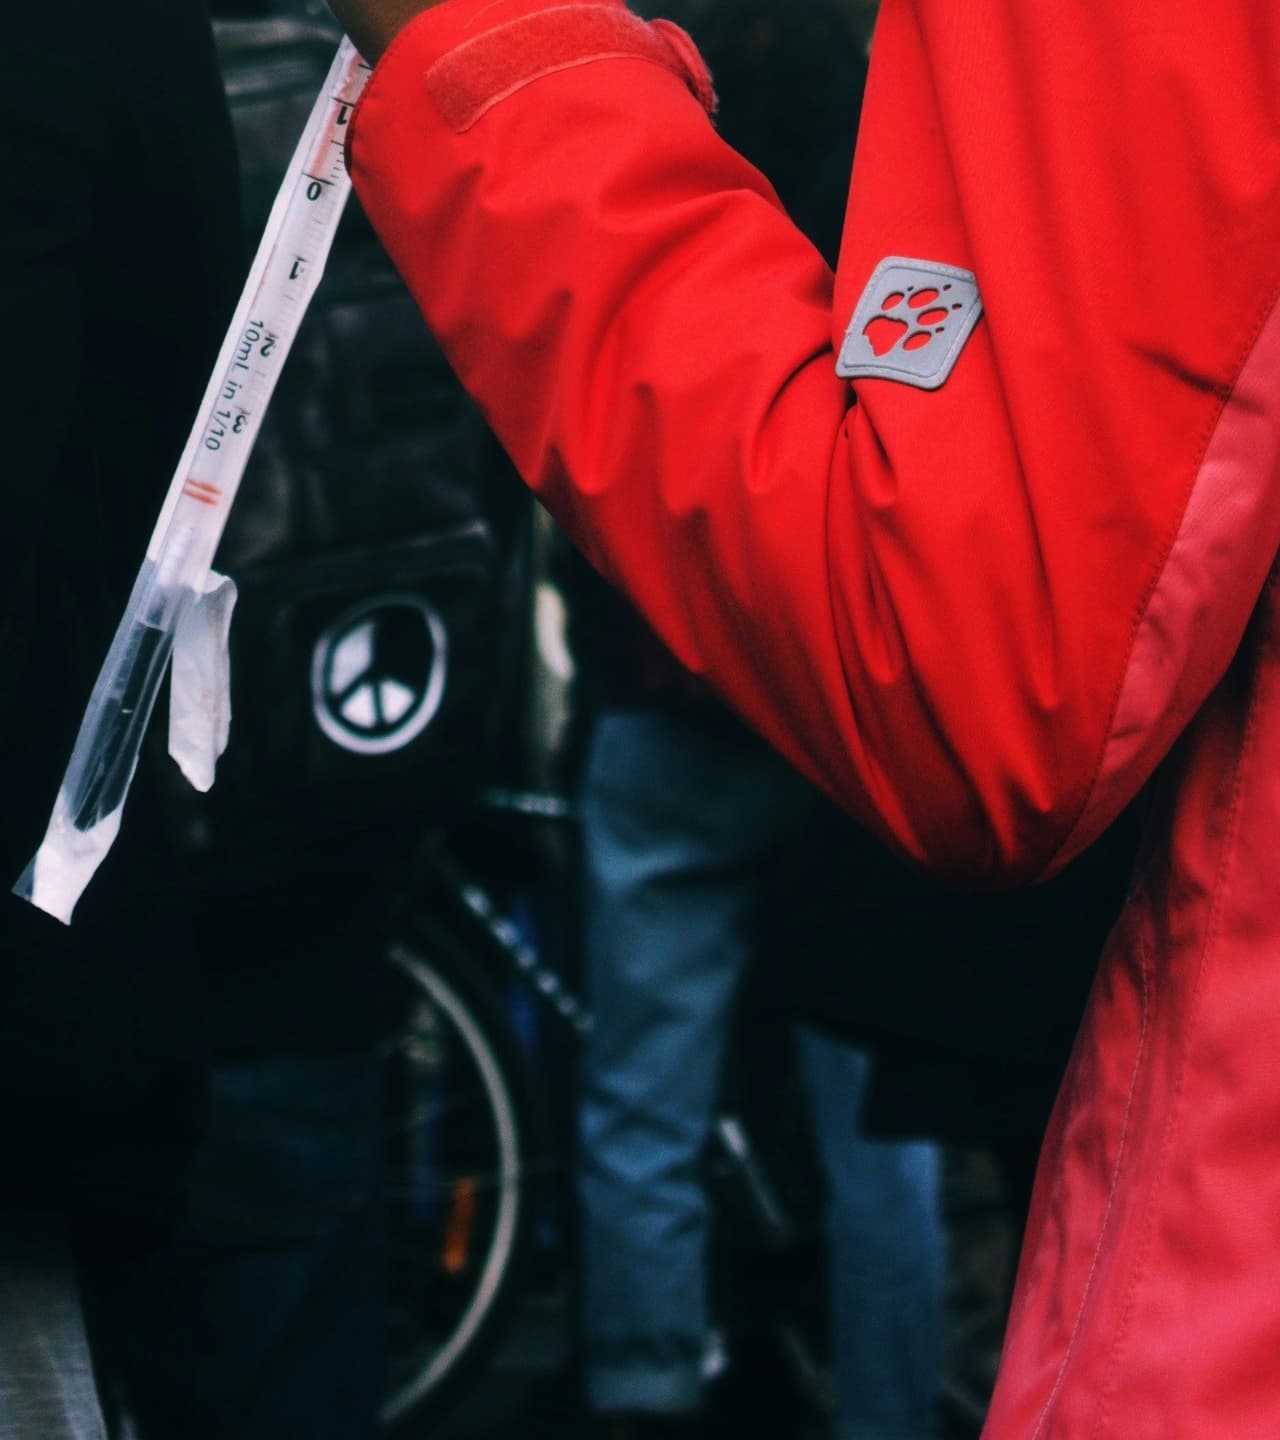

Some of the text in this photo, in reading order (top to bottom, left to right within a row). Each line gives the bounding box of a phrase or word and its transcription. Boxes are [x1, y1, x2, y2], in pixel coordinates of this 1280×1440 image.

[306, 181, 322, 201] 0
[222, 380, 243, 401] in
[204, 410, 232, 452] 1/10
